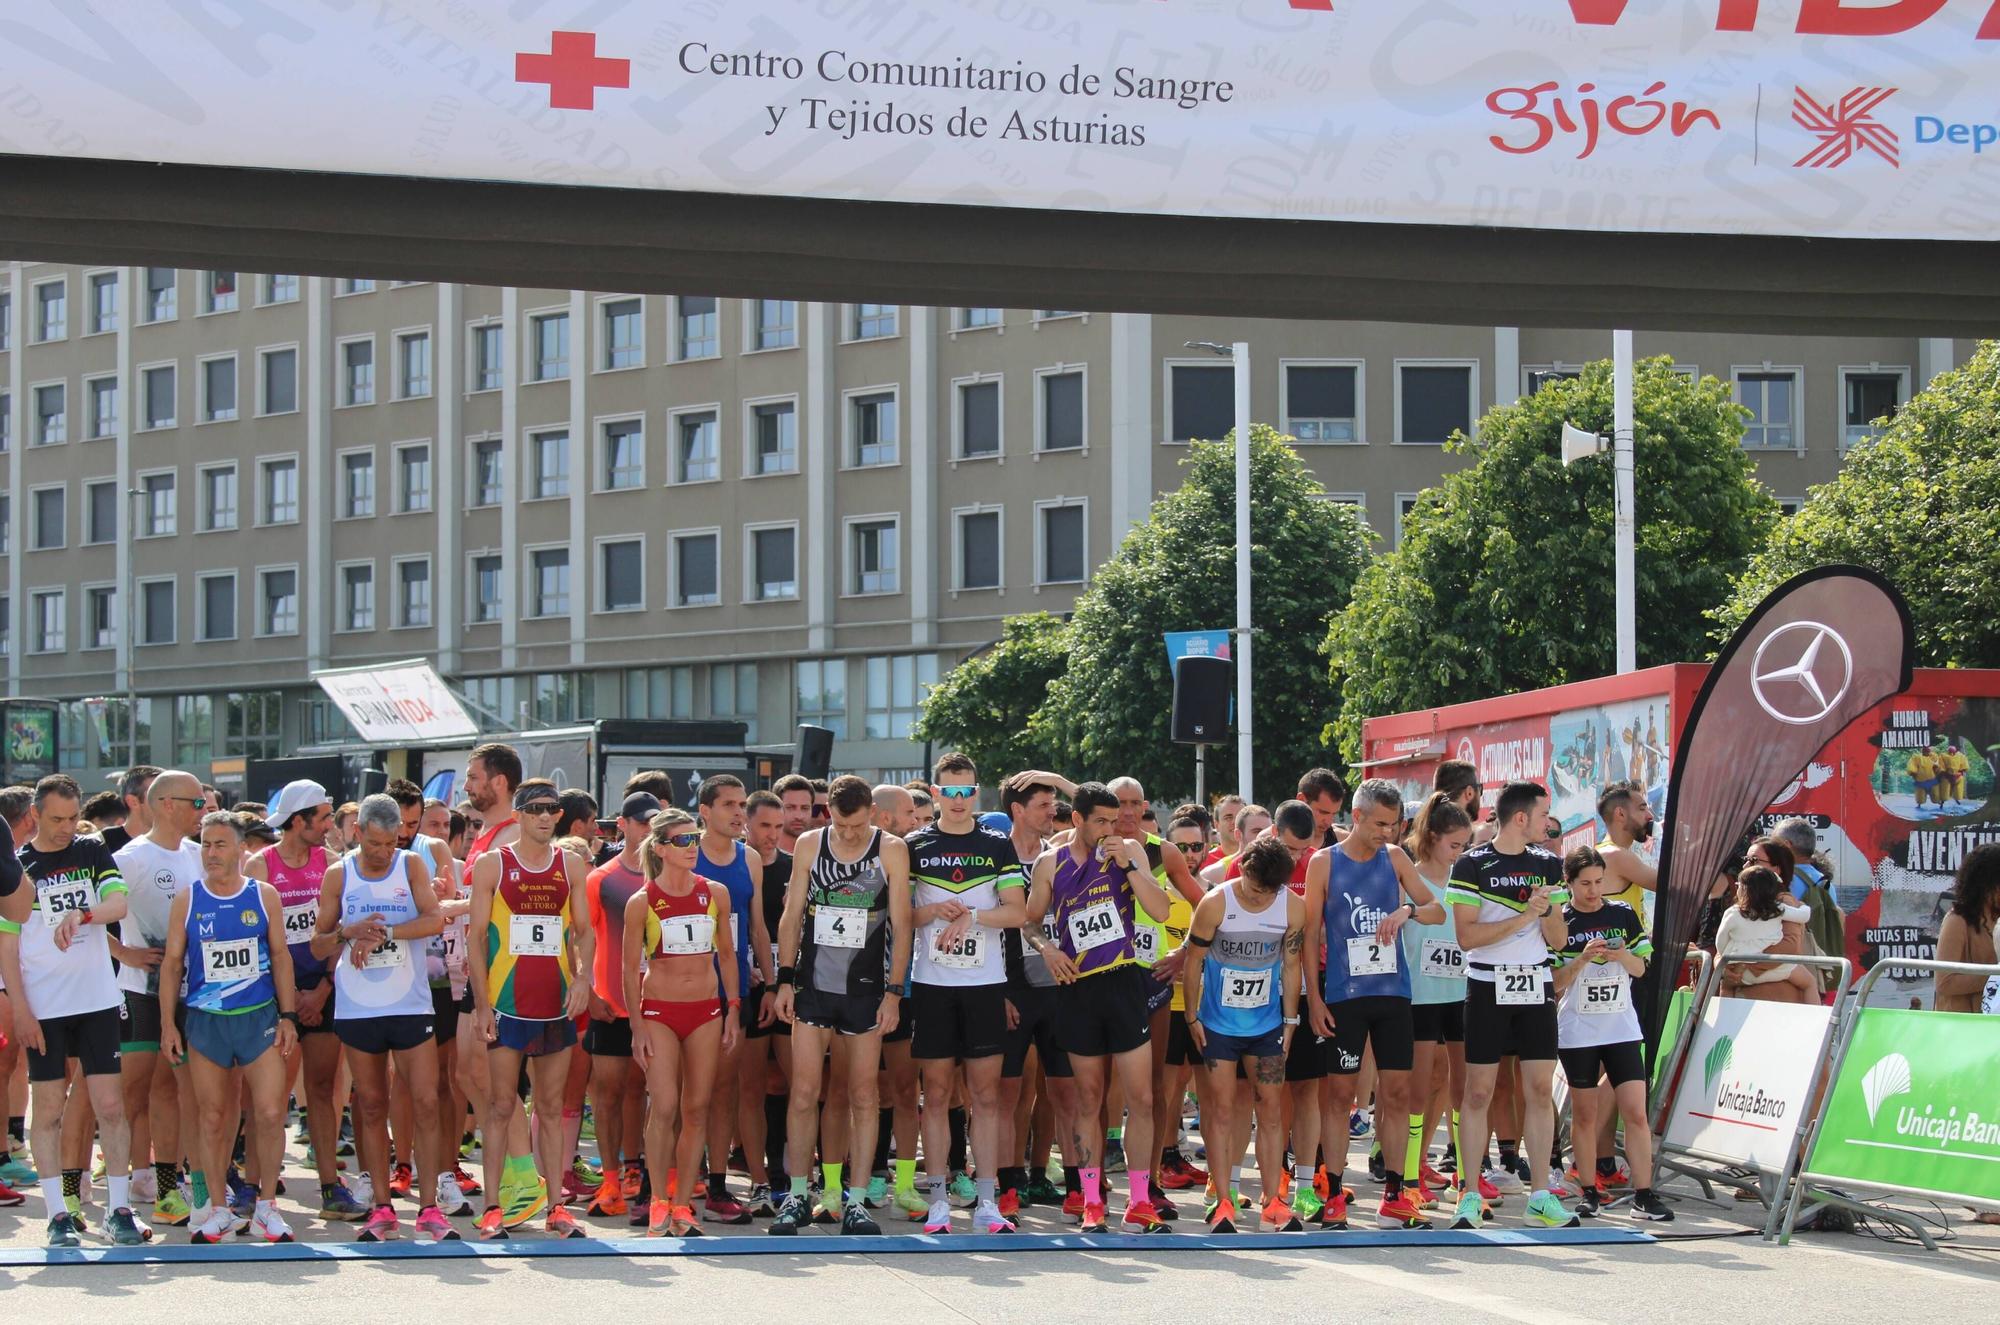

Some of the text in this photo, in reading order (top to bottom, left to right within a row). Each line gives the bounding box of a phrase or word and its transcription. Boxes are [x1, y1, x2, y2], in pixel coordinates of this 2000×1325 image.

[679, 42, 1235, 110] Centro Comunitario de Sangre
[764, 99, 1146, 147] y Tejidos de Asturias
[1486, 79, 1721, 159] gijón
[1914, 115, 2000, 154] Dep
[1892, 710, 1929, 728] HUMOR
[1881, 730, 1931, 748] AMARILLO
[920, 856, 995, 868] DONAVIDA
[1088, 884, 1110, 896] PRIM
[1489, 875, 1547, 888] DONAVIDA
[49, 889, 89, 914] 532
[360, 904, 408, 913] alvemaco
[285, 910, 317, 932] 483
[832, 917, 846, 935] 4
[1075, 911, 1113, 938] 340
[532, 925, 544, 942] 6
[685, 924, 694, 942] 1
[1567, 928, 1628, 946] DONAVIDA
[1866, 928, 1919, 943] RUTAS EN
[211, 948, 250, 969] 200
[1368, 945, 1381, 962] 2
[1430, 948, 1462, 967] 416
[1232, 979, 1265, 996] 377
[1504, 975, 1535, 993] 221
[1587, 984, 1620, 1003] 557
[1717, 1081, 1786, 1120] Unicaja Banco
[1895, 1104, 2000, 1148] Unicaja Ban
